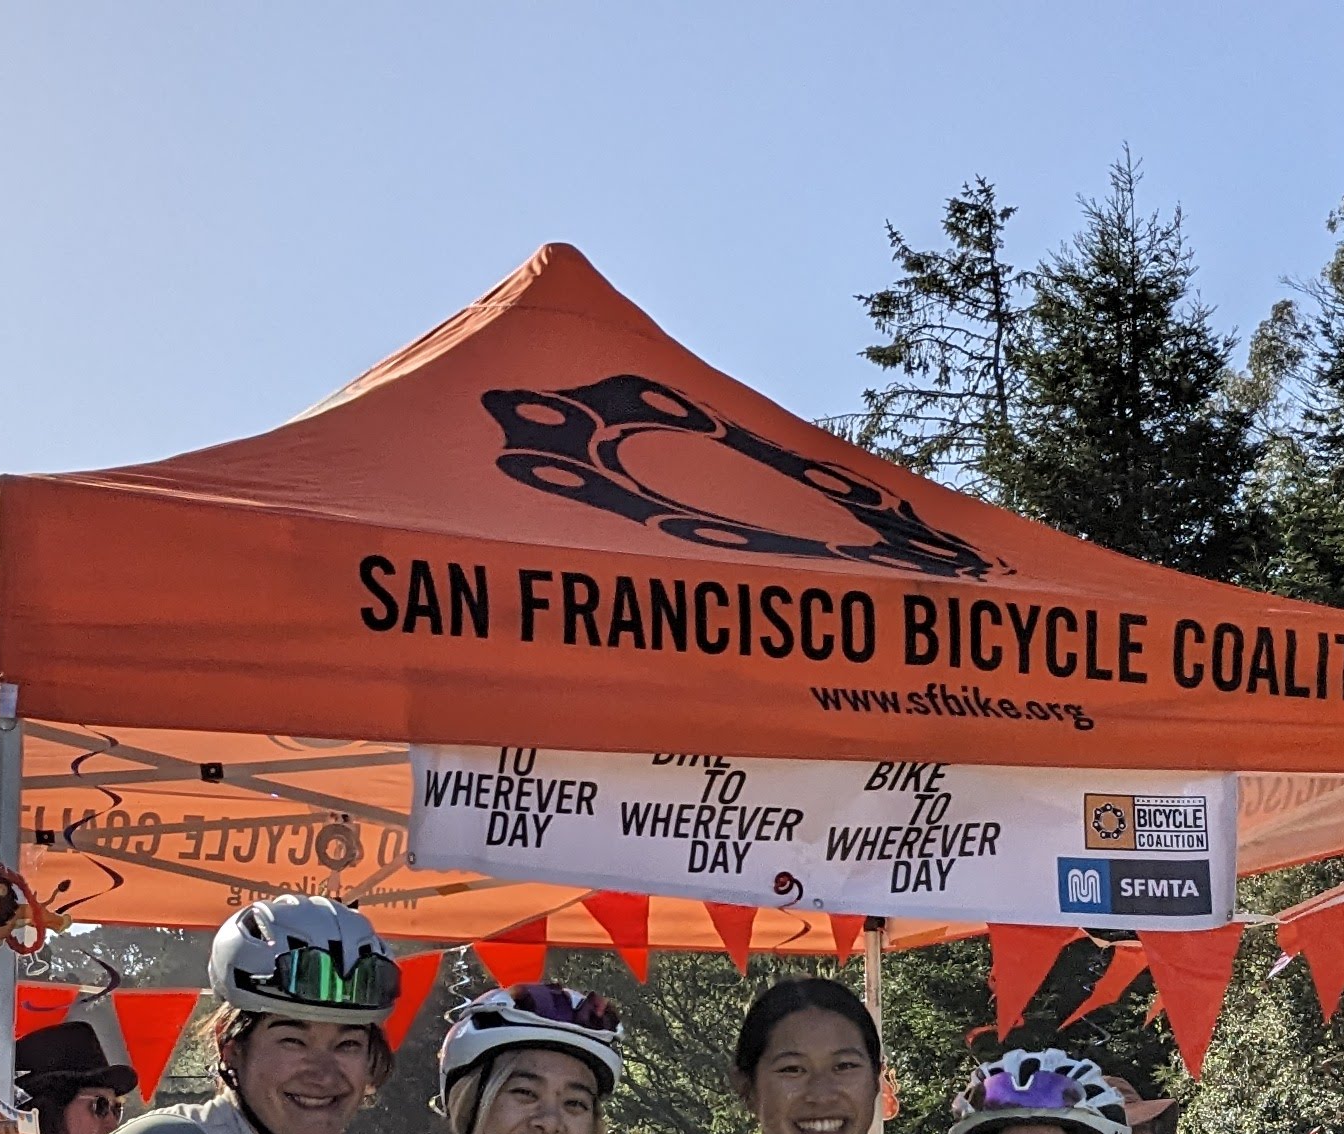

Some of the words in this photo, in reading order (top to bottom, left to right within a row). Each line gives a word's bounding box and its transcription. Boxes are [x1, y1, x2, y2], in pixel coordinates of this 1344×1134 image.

[359, 554, 489, 638] SAN
[518, 568, 876, 663] FRANCISCO
[903, 594, 1148, 684] BICYCLE
[810, 683, 1095, 731] www.sfbike.org
[424, 770, 598, 816] WHEREVER
[700, 769, 747, 804] TO
[864, 761, 951, 792] BIKE
[621, 801, 804, 842] WHEREVER
[909, 792, 952, 826] TO
[1137, 808, 1203, 829] BICYCLE
[486, 811, 553, 848] DAY
[826, 822, 1001, 861] WHEREVER
[1138, 833, 1205, 848] COALITION
[687, 840, 752, 874] DAY
[890, 858, 956, 893] DAY
[1120, 878, 1200, 898] SFMTA
